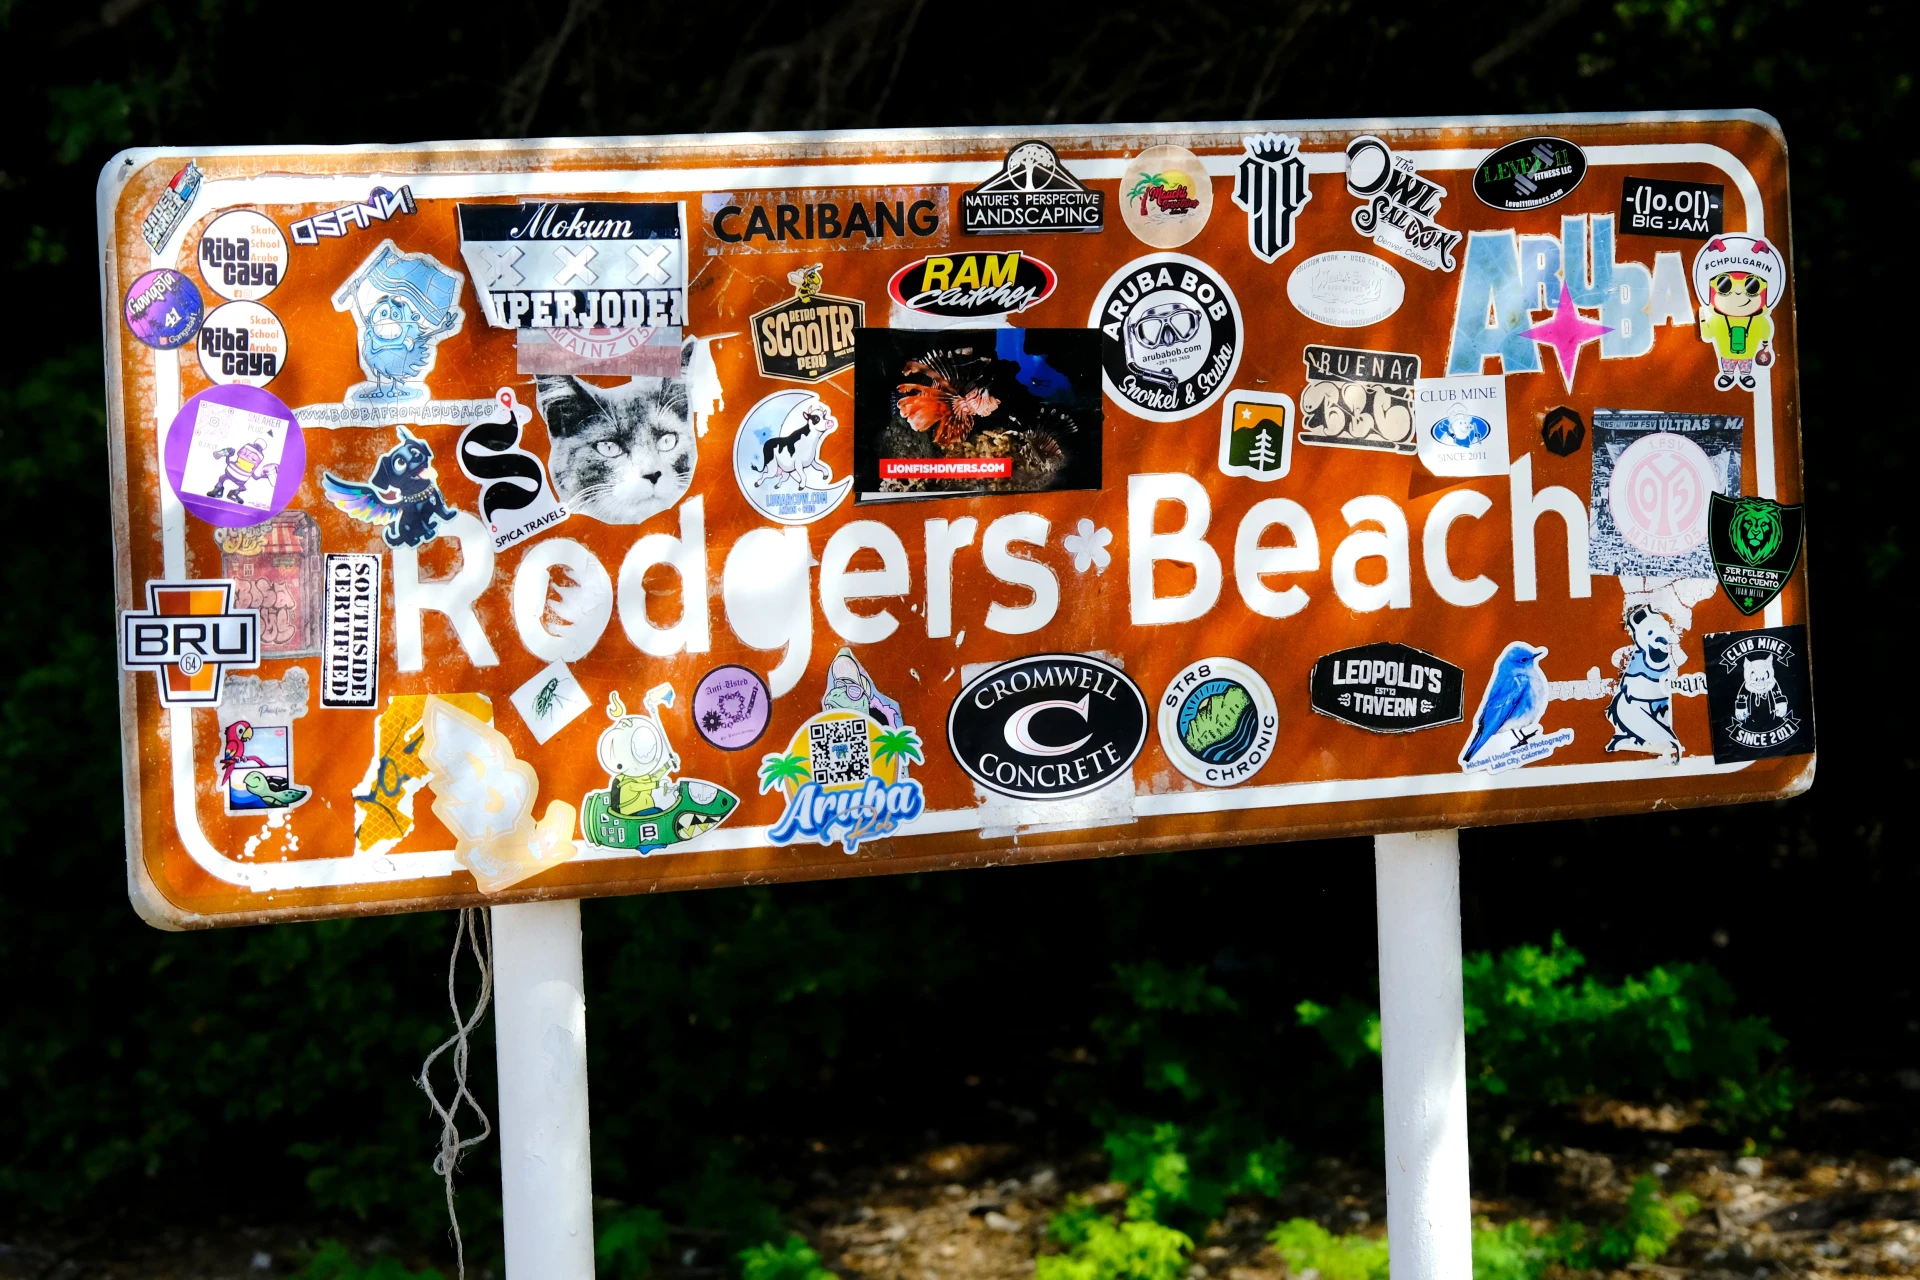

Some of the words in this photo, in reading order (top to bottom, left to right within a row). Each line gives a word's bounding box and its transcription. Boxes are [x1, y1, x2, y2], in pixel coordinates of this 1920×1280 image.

[1347, 140, 1441, 217] OWL
[1395, 155, 1414, 172] The
[1534, 168, 1561, 181] FITNESS
[1561, 165, 1573, 175] LLC
[143, 186, 173, 236] JADER
[966, 194, 1019, 206] NATURE'S
[1025, 193, 1100, 206] PERSPECTIVE
[146, 193, 185, 244] BARBER
[251, 225, 277, 235] Skate
[510, 202, 633, 238] Mokum
[713, 200, 940, 243] CARIBANG
[966, 206, 1099, 225] LANDSCAPING
[1632, 214, 1664, 229] BIG
[251, 239, 280, 249] School
[1356, 195, 1458, 269] SALOON
[202, 237, 250, 268] Riba
[251, 253, 279, 263] Aruba
[1322, 254, 1339, 263] WORK
[1350, 254, 1366, 263] USED
[1377, 235, 1402, 253] Denver,
[1405, 249, 1436, 268] Colorado
[1705, 256, 1773, 273] #CHPULGARIN
[921, 252, 1020, 293] RAM
[128, 272, 176, 315] Gangsta
[1103, 267, 1174, 342] ARUBA
[1180, 270, 1228, 322] BOB
[1446, 213, 1697, 377] ARUBA
[165, 307, 182, 328] 41
[250, 316, 276, 325] Skate
[789, 308, 816, 323] RETRO
[201, 327, 249, 357] Riba
[250, 329, 279, 339] School
[551, 328, 620, 358] MAINZ
[627, 328, 650, 347] 05
[762, 305, 855, 357] SCOOTER
[250, 343, 278, 353] Aruba
[1142, 344, 1202, 363] arubabob.com
[1118, 374, 1180, 410] Snorkel
[1185, 382, 1196, 404] &
[1197, 342, 1233, 396] Scuba
[1420, 389, 1457, 403] CLUB
[1461, 387, 1497, 400] MINE
[1658, 417, 1711, 431] ULTRAS
[887, 463, 1005, 474] LIONFISHDIVERS.COM
[1438, 453, 1466, 462] SINCE
[1468, 452, 1487, 461] 2011
[495, 528, 525, 548] SPICA
[523, 507, 567, 533] TRAVELS
[1627, 526, 1681, 553] MAINZ
[1684, 526, 1702, 546] 05
[391, 495, 1060, 698] Rodgers
[1127, 453, 1592, 626] Beach
[1723, 574, 1748, 584] TANTO
[1748, 577, 1780, 588] CUENTO
[135, 623, 248, 656] BRU
[331, 562, 351, 697] CERTIFIED
[352, 562, 370, 697] SOUTHSIDE
[185, 656, 197, 671] 64
[1726, 638, 1755, 662] CLUB
[1757, 637, 1785, 655] MINE
[974, 666, 1120, 710] CROMWELL
[1166, 664, 1212, 708] STR8
[1333, 659, 1443, 694] LEOPOLD'S
[1353, 691, 1418, 717] TAVERN
[1003, 692, 1094, 757] C
[1735, 729, 1768, 746] SINCE
[1769, 723, 1796, 744] 2011
[1205, 715, 1275, 781] CHRONIC
[1466, 757, 1492, 770] Michael
[1492, 744, 1529, 762] Underwood
[1529, 733, 1571, 750] Photography
[1491, 761, 1506, 770] Lake
[1521, 748, 1549, 761] Colorado
[978, 741, 1122, 788] CONCRETE
[769, 778, 918, 841] Aruba
[642, 825, 657, 838] B
